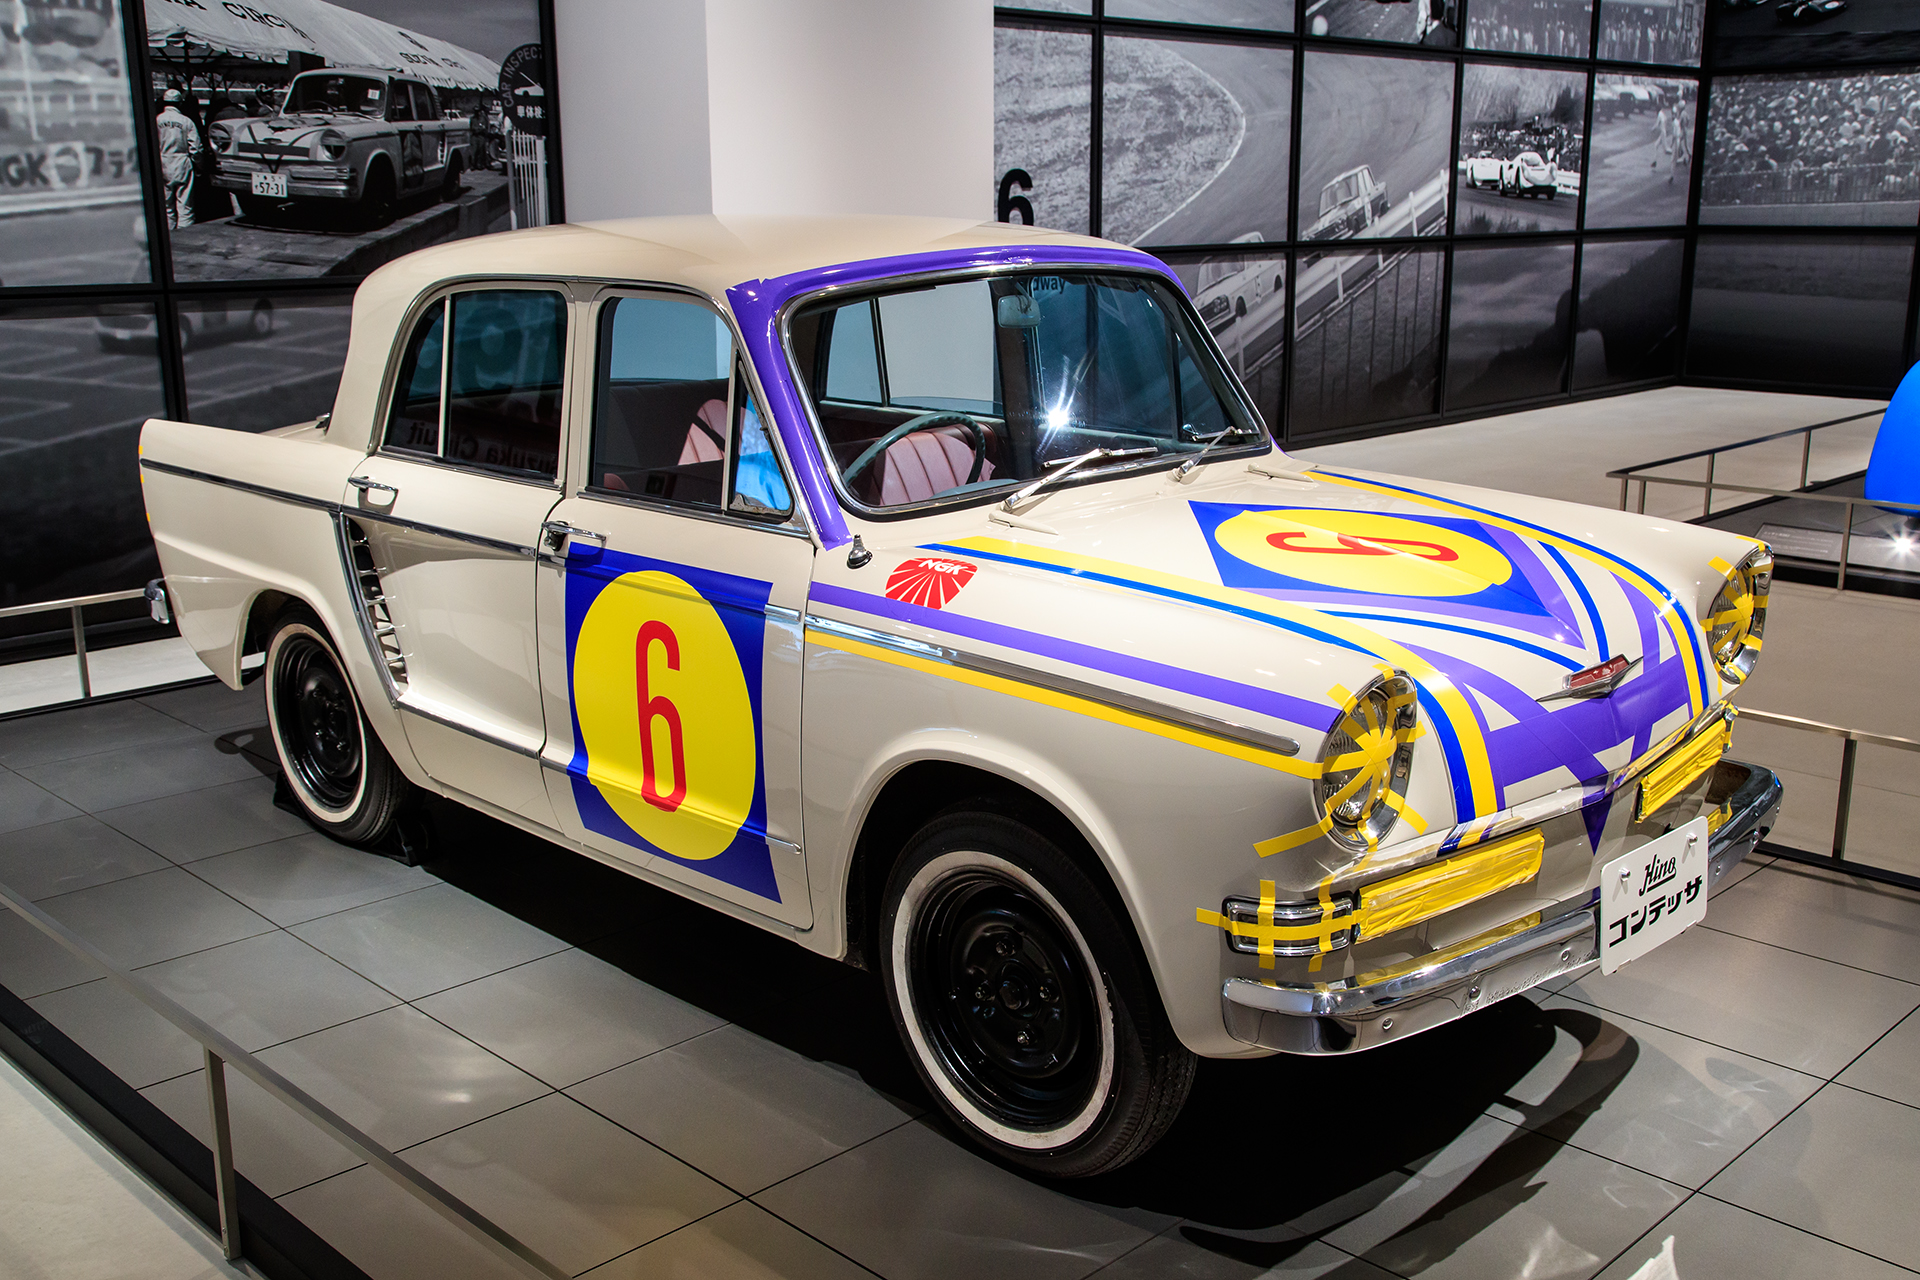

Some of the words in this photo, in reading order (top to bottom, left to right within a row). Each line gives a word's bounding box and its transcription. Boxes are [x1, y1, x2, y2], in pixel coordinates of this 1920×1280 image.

[501, 82, 514, 107] CAR
[259, 182, 285, 196] 57-31
[918, 558, 969, 576] NGK
[636, 620, 687, 812] 6
[1638, 854, 1678, 897] Hino
[1609, 875, 1703, 948] コンテッサ
